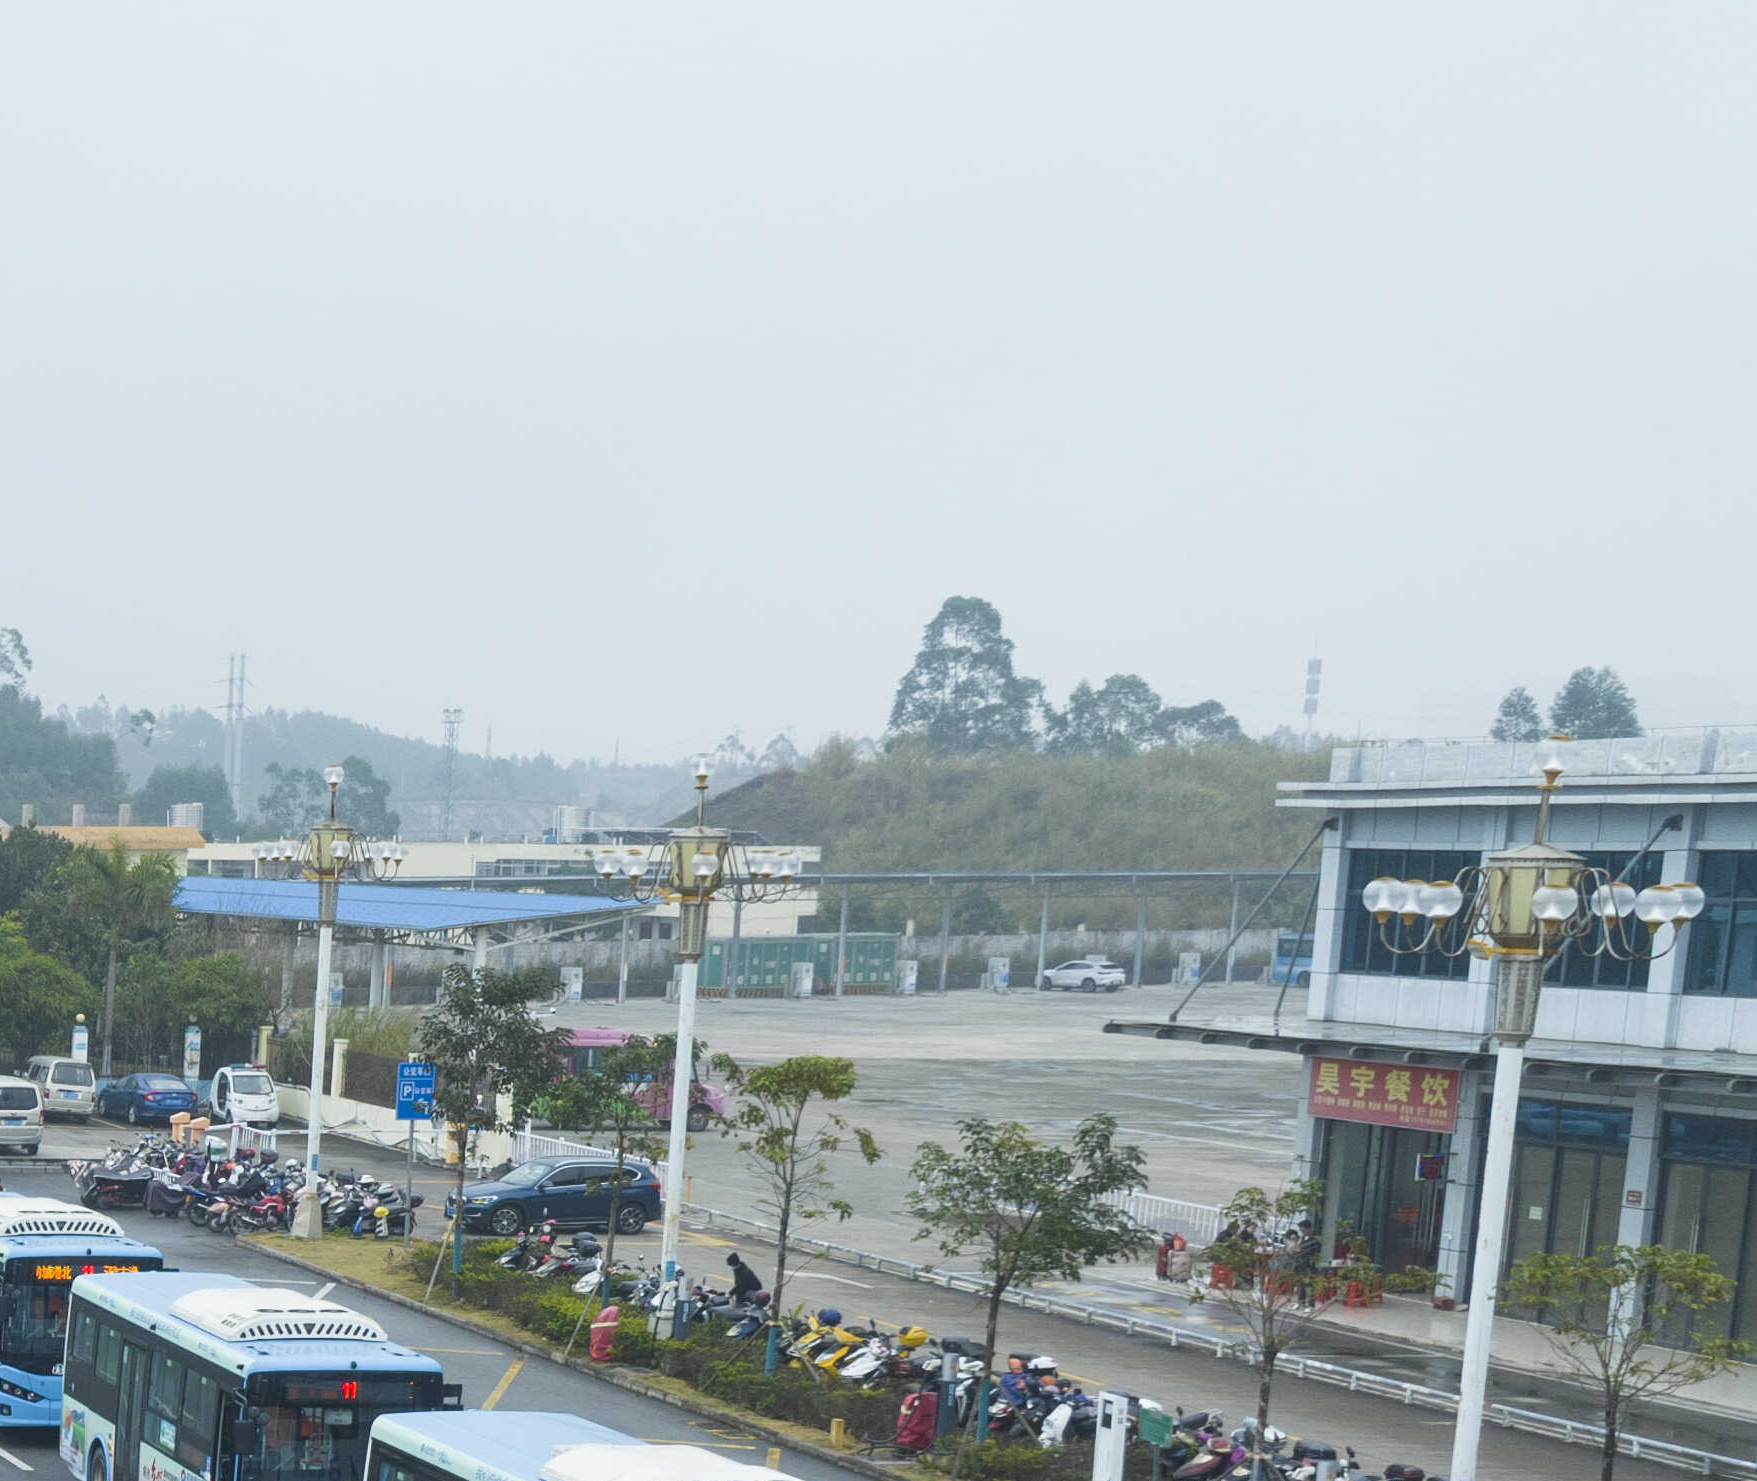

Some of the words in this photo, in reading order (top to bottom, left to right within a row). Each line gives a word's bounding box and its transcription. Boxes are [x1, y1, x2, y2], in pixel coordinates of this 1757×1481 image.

[1315, 1062, 1451, 1106] 昊宇餐饮
[342, 1381, 358, 1400] 11
